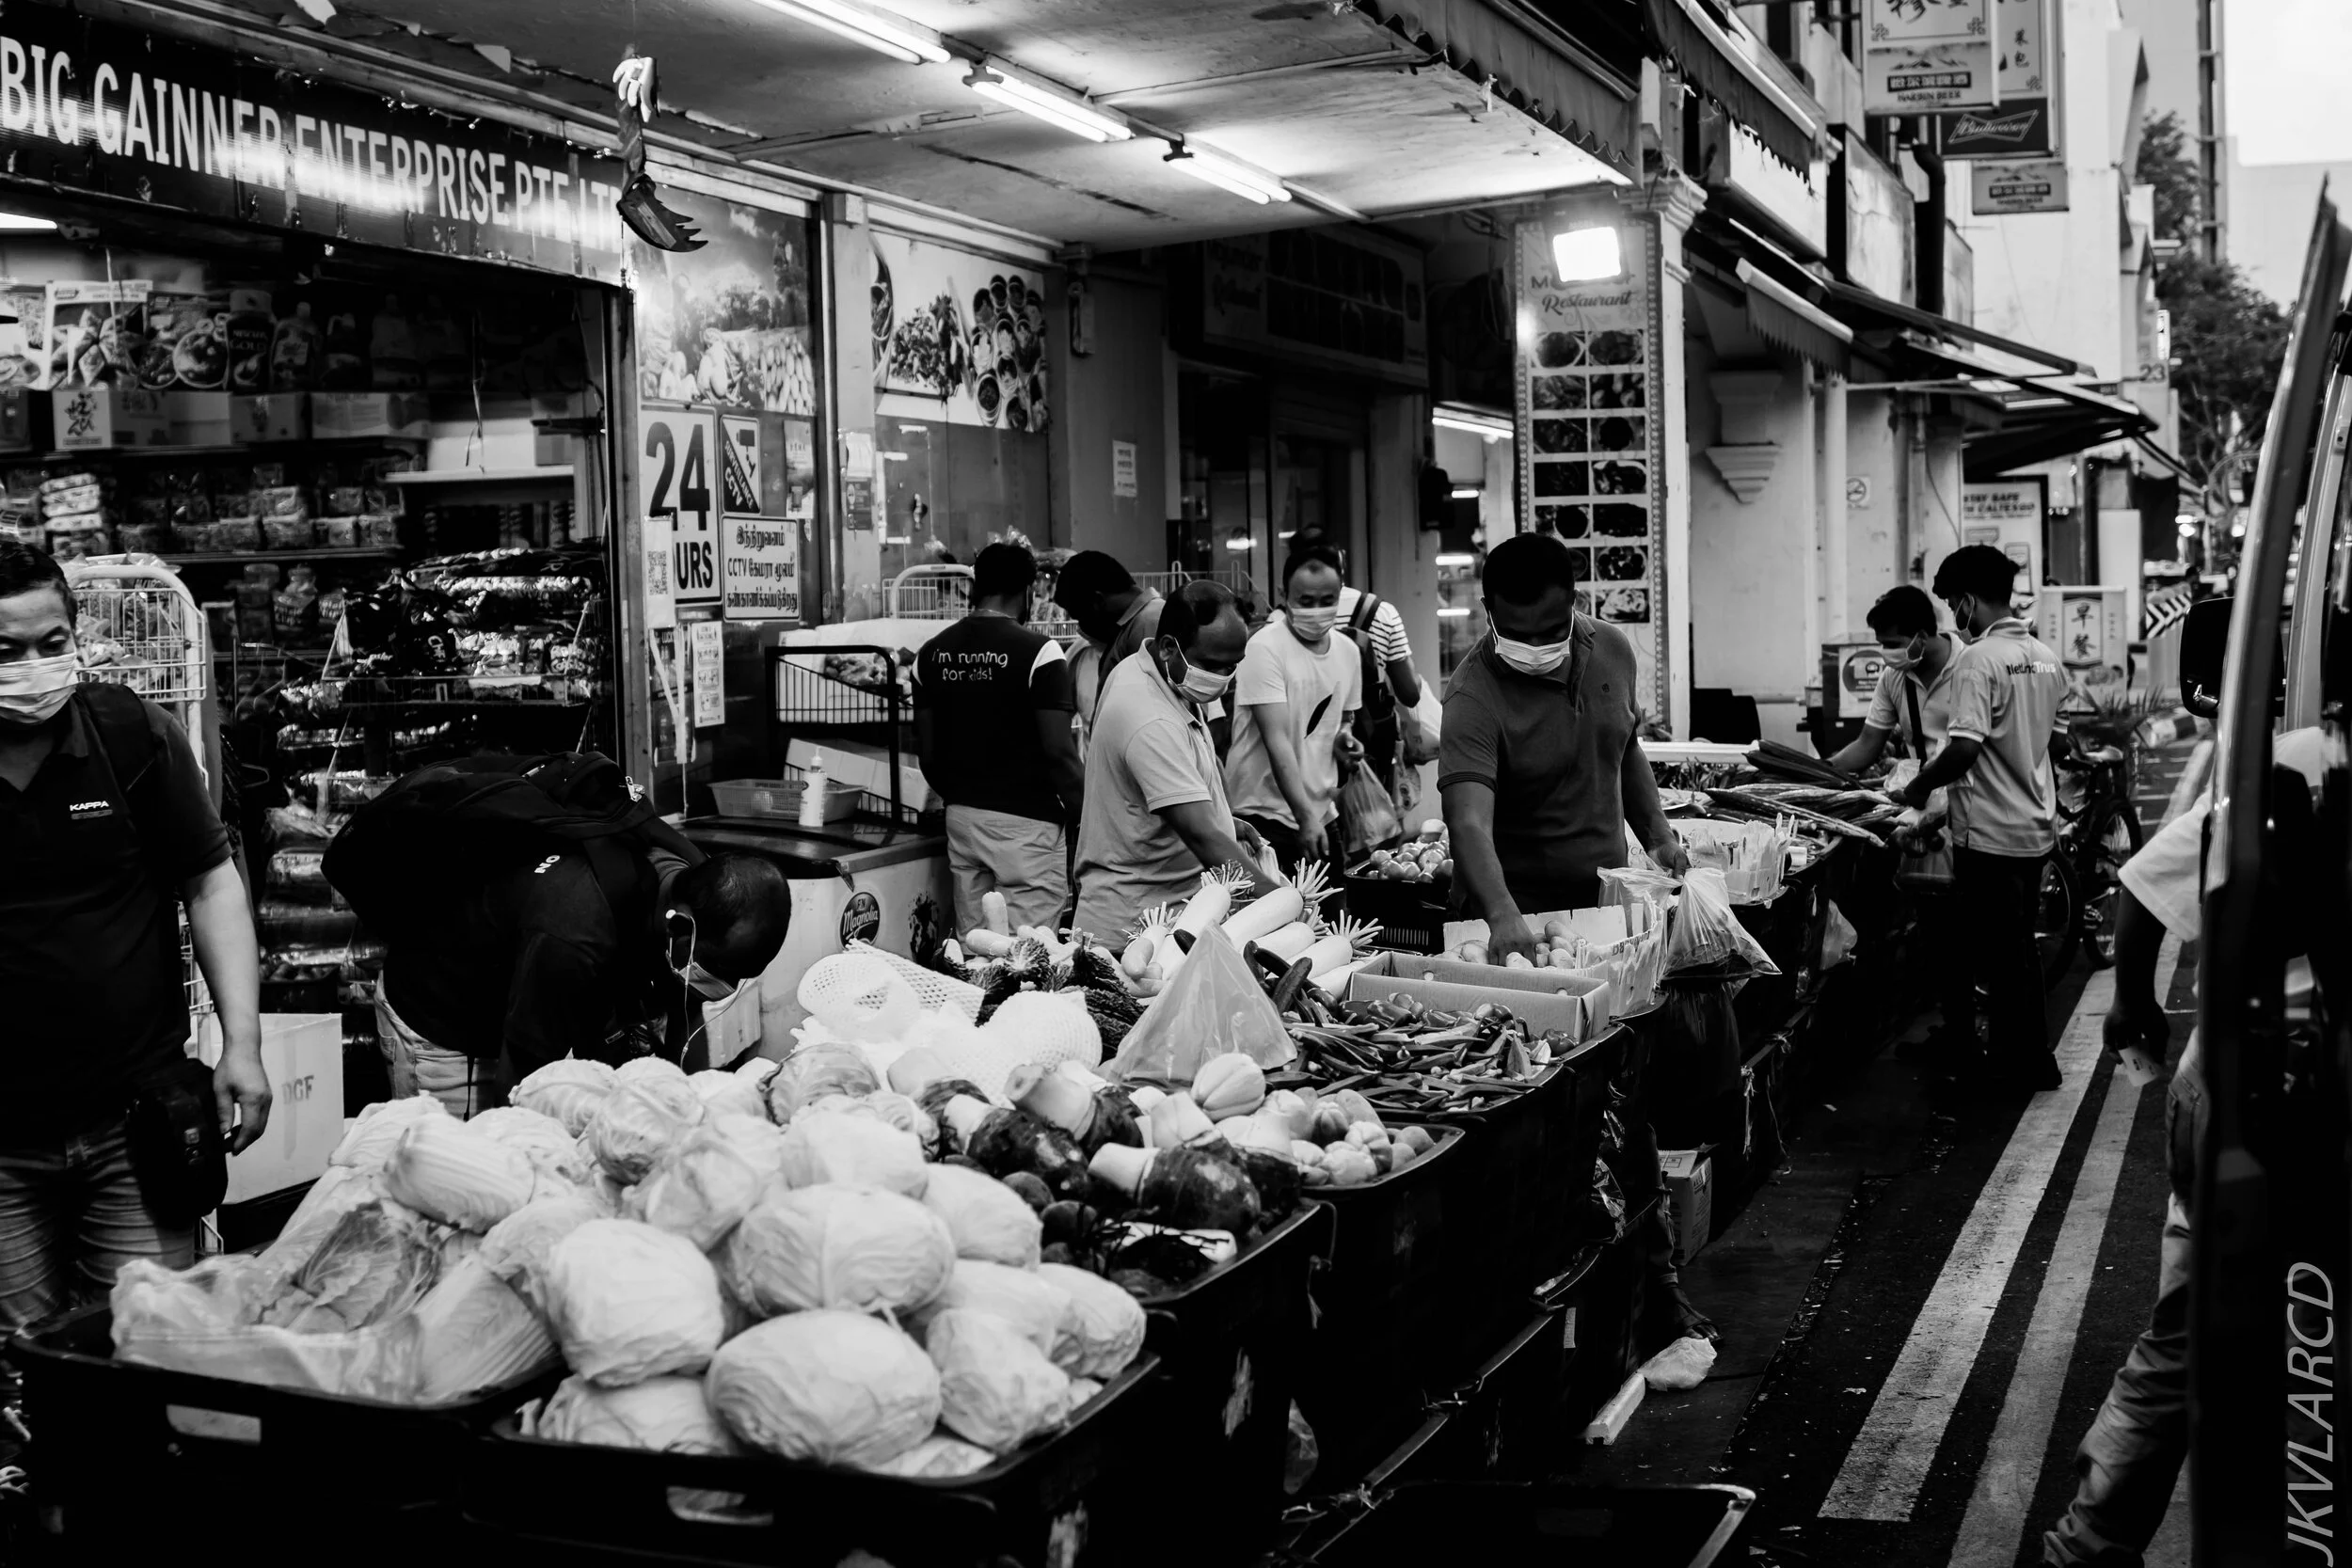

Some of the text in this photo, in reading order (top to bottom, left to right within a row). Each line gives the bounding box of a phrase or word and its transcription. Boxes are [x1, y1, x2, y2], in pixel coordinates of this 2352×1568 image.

[0, 36, 79, 146] BIG
[94, 63, 285, 190] GAINNER
[295, 114, 510, 227] ENTERPRISE
[515, 160, 572, 245] PTE
[1542, 290, 1632, 315] Restaurant
[646, 421, 710, 531] 24
[725, 440, 754, 509] SURVEILLANCE
[725, 467, 743, 506] CCTV
[675, 541, 713, 590] URS
[727, 557, 748, 578] CCTV
[943, 668, 966, 681] for
[958, 651, 1009, 668] running
[69, 800, 110, 812] KAPPA
[843, 904, 879, 936] Magnolia
